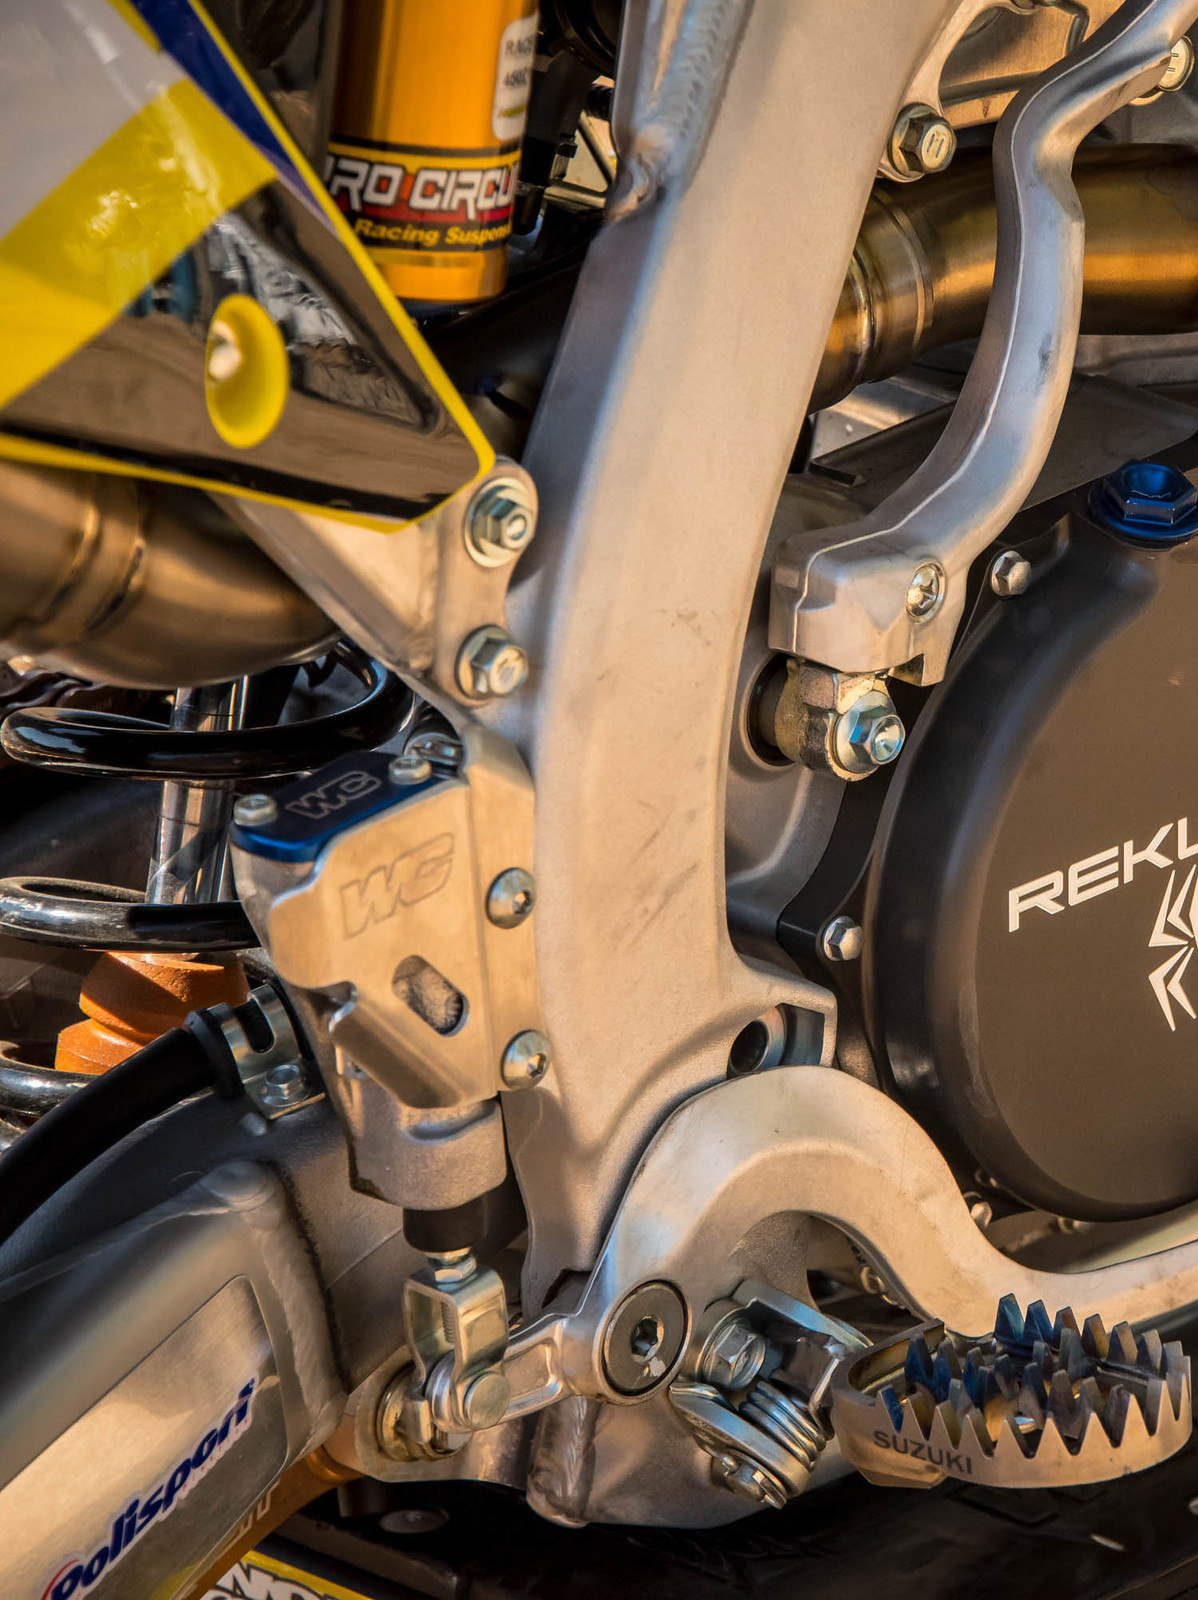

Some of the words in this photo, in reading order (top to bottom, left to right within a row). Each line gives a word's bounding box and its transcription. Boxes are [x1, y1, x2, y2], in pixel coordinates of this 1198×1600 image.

[408, 164, 520, 221] CIRCU
[354, 218, 441, 247] Racing
[873, 1429, 973, 1475] SUZUKI
